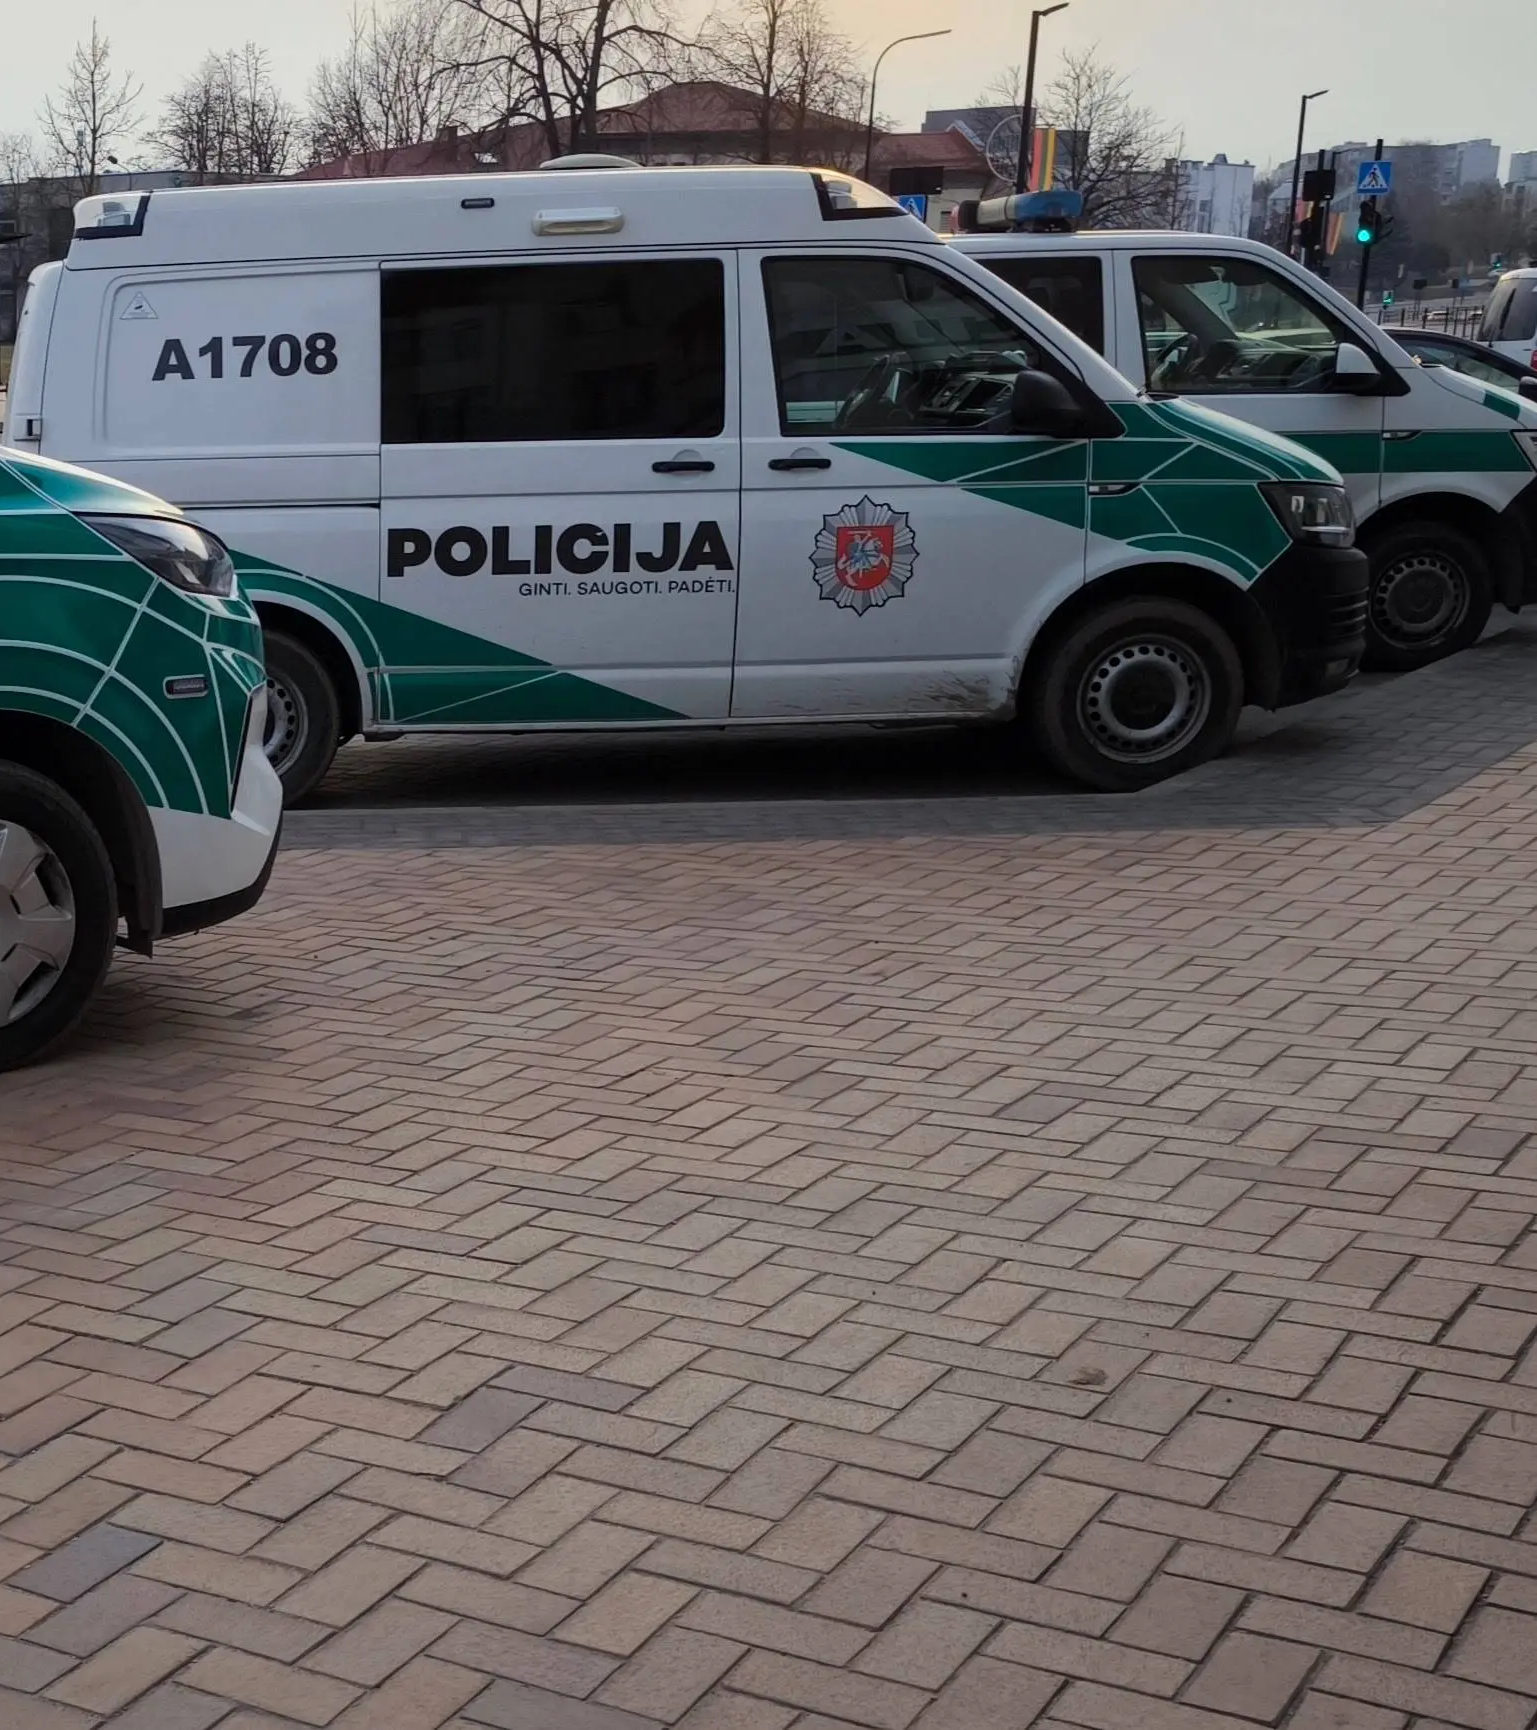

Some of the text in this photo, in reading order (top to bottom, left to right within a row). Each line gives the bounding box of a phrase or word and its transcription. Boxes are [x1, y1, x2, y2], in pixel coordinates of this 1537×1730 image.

[151, 331, 339, 382] A1708
[387, 520, 735, 578] POLICIJA
[518, 576, 736, 597] GINTI. SAUGOTI. PADĖTI.
